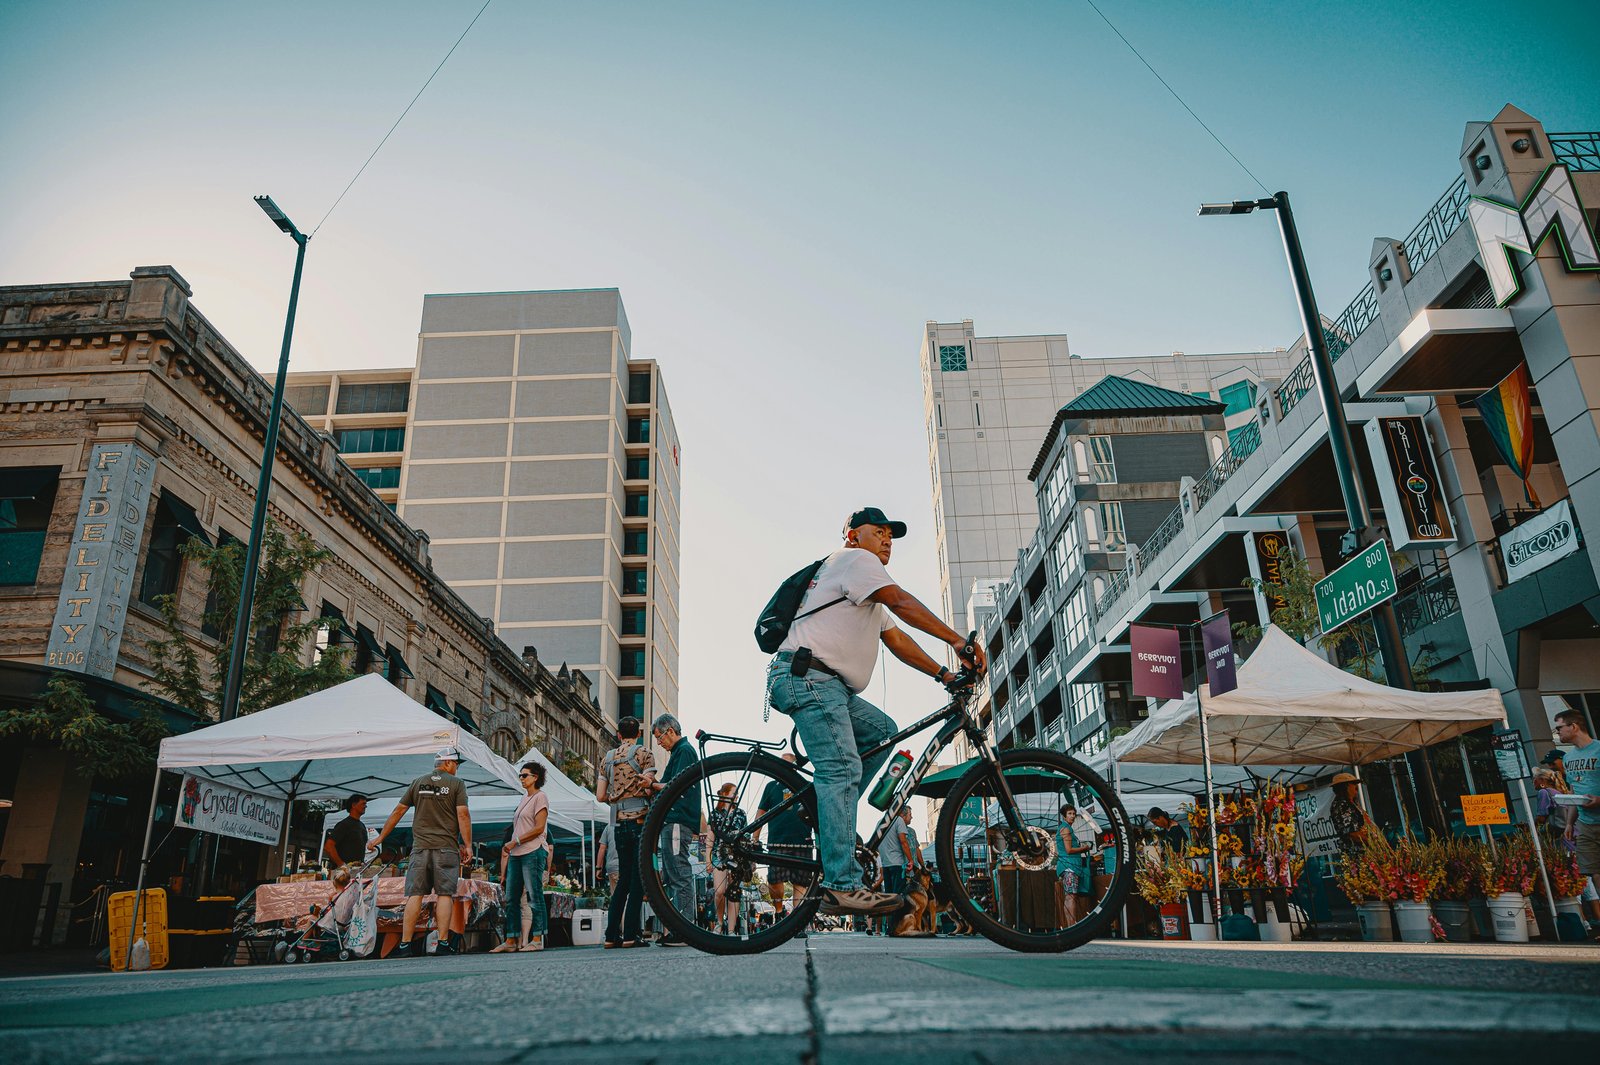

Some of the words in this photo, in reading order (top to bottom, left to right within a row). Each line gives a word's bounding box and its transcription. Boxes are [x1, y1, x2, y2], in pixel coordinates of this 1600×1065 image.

[1396, 421, 1428, 523] BALCONY
[59, 451, 123, 644] FIDELITY
[1418, 524, 1441, 537] CLUB
[1510, 524, 1565, 564] BALCONY
[99, 454, 150, 650] FIDELITY
[1365, 549, 1382, 568] 800
[1320, 581, 1334, 598] 700
[1324, 611, 1332, 625] W
[1333, 579, 1376, 620] Idaho
[1150, 665, 1167, 674] JAM
[1216, 658, 1226, 669] JAM
[876, 736, 941, 839] NORCO
[202, 788, 242, 822] Crystal
[241, 794, 281, 831] Gardens
[1119, 825, 1130, 865] PATROL
[1318, 843, 1332, 851] est.
